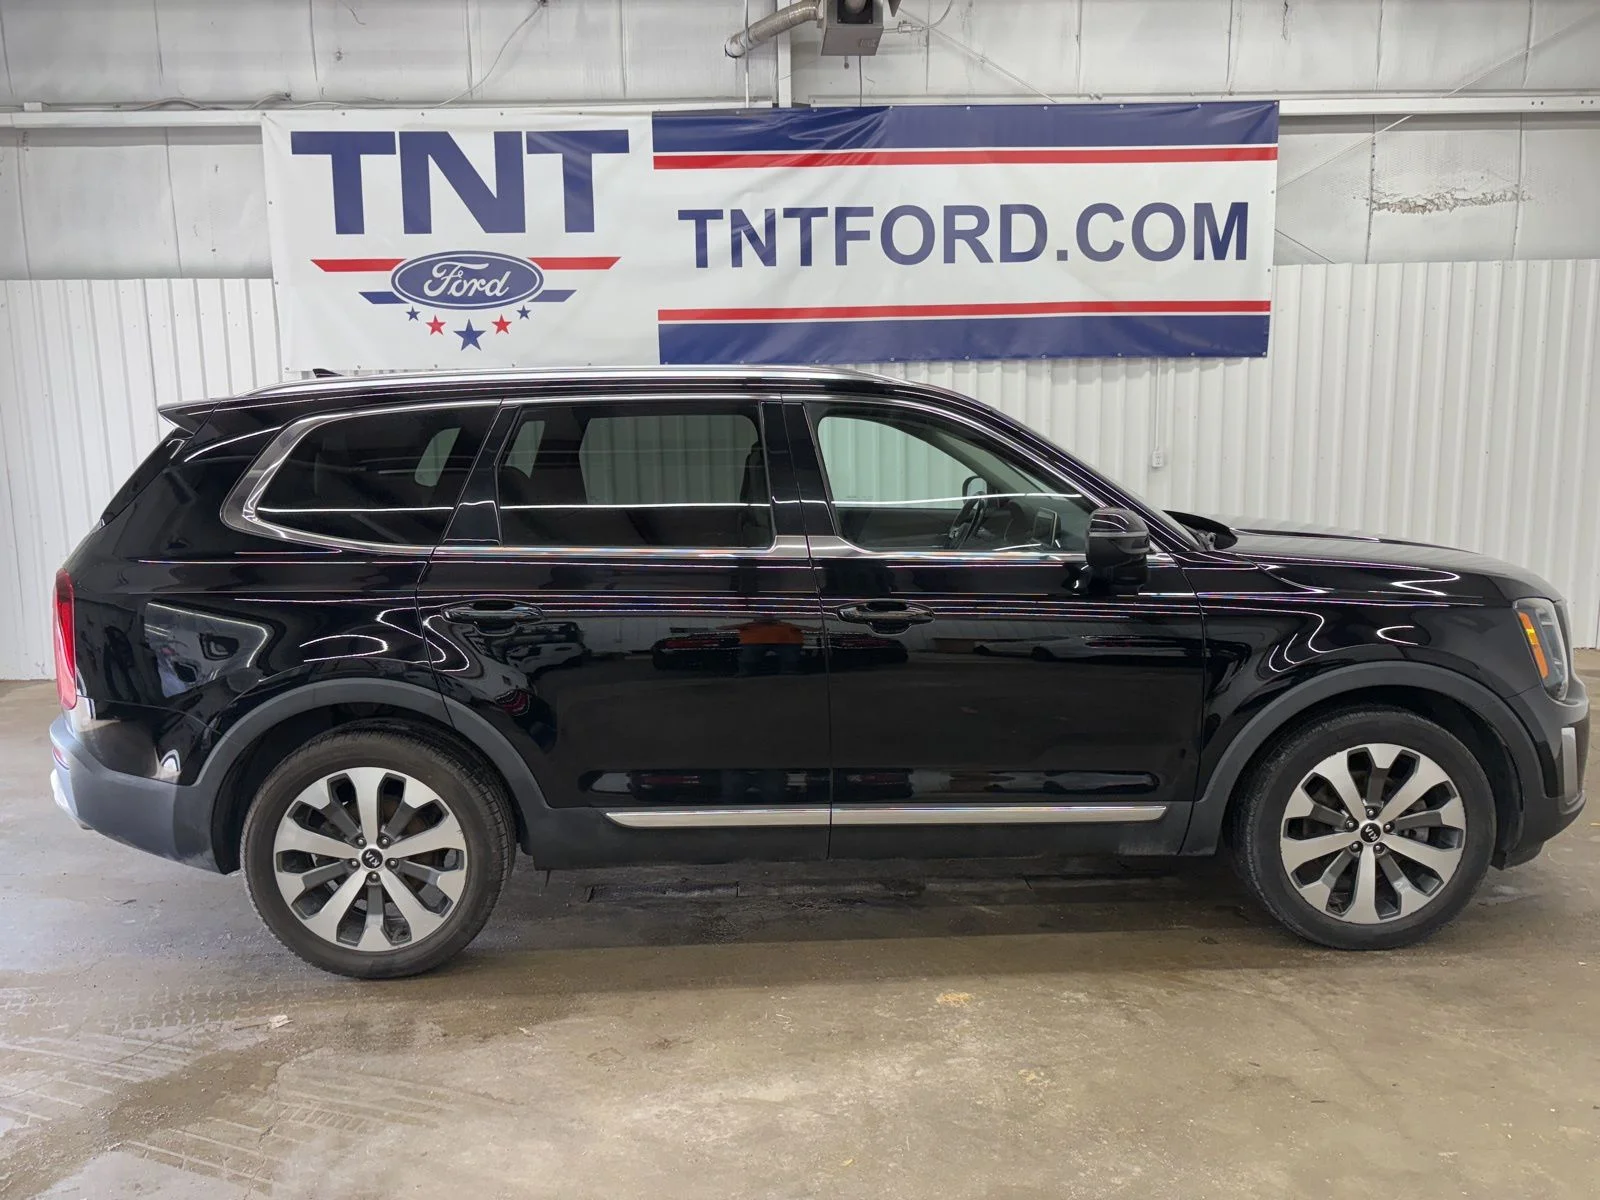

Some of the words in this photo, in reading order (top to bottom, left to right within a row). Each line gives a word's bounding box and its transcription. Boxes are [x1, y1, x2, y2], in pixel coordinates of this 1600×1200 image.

[291, 129, 629, 234] TNT
[678, 202, 1247, 268] TNTFORD.COM
[423, 261, 512, 298] Ford
[365, 850, 380, 867] KIA
